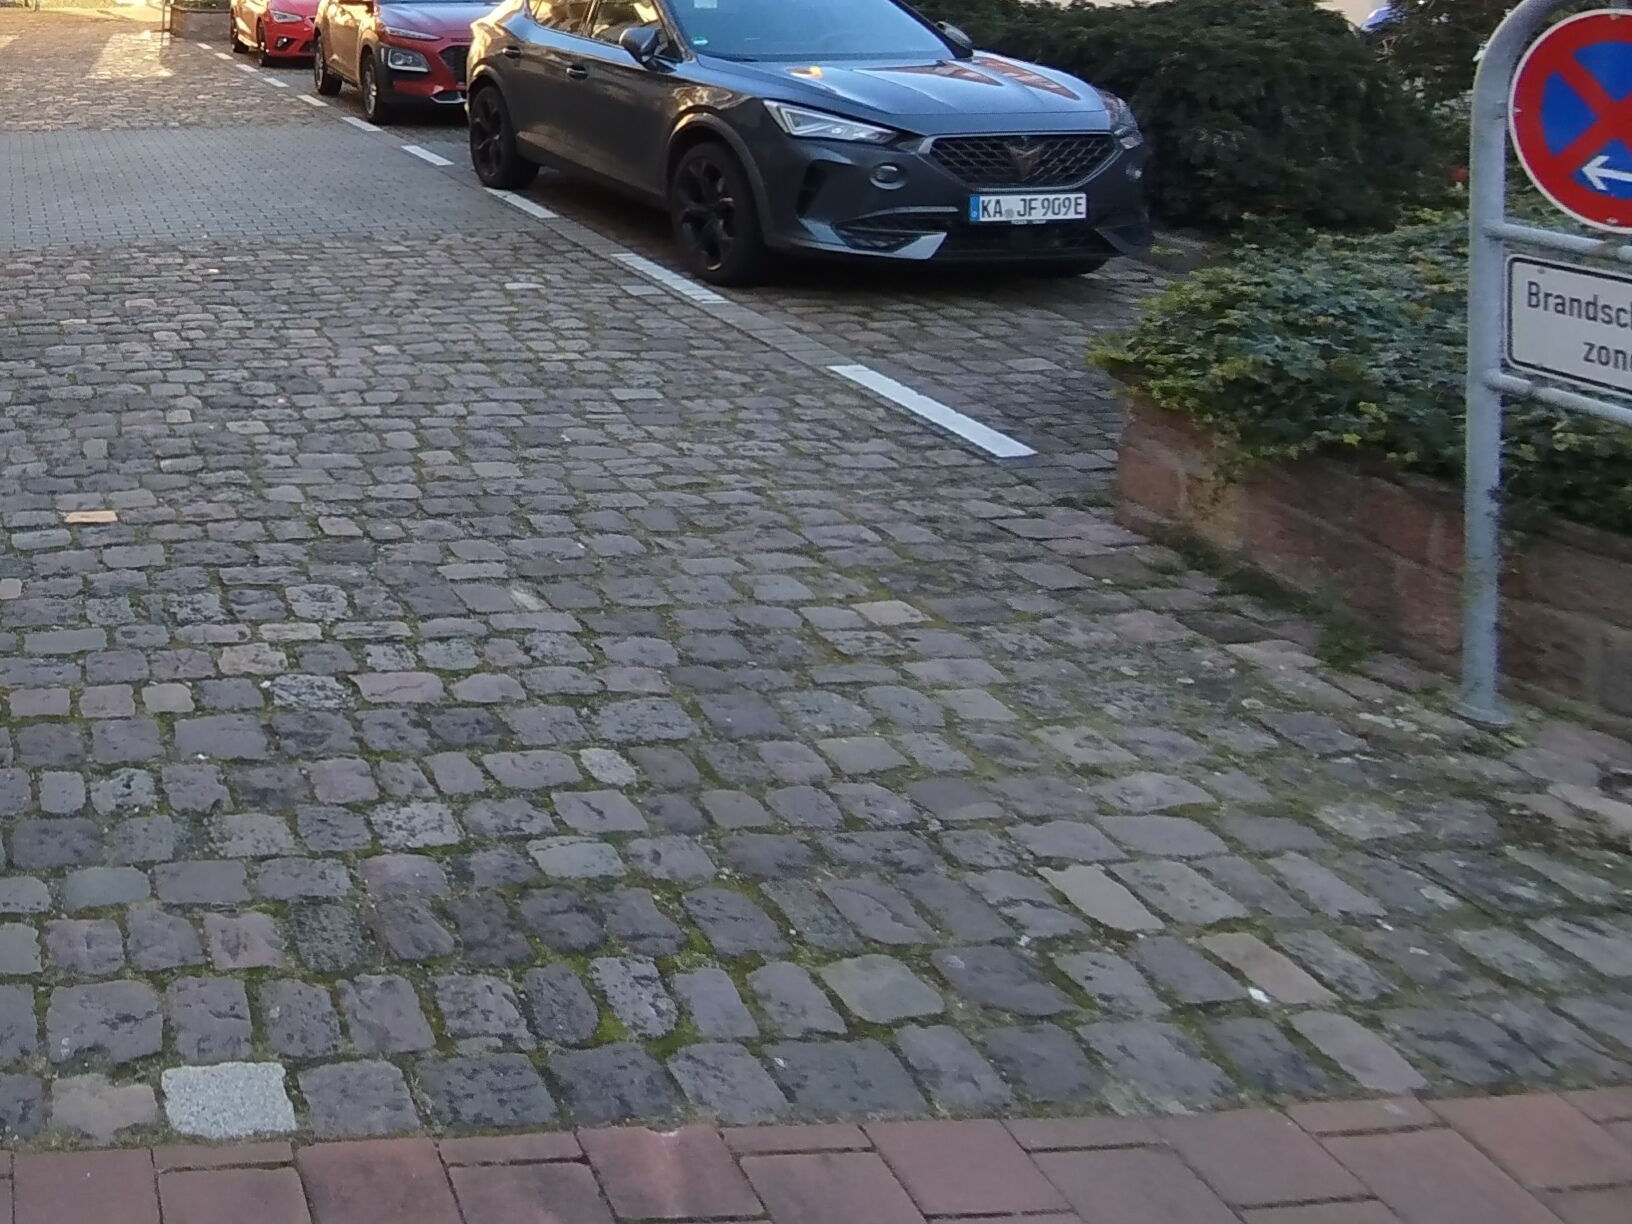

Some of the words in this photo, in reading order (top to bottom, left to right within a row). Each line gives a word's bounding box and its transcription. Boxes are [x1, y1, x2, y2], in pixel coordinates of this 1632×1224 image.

[981, 199, 1003, 218] KA
[1528, 280, 1632, 330] Brandsc
[1583, 341, 1632, 373] zon
